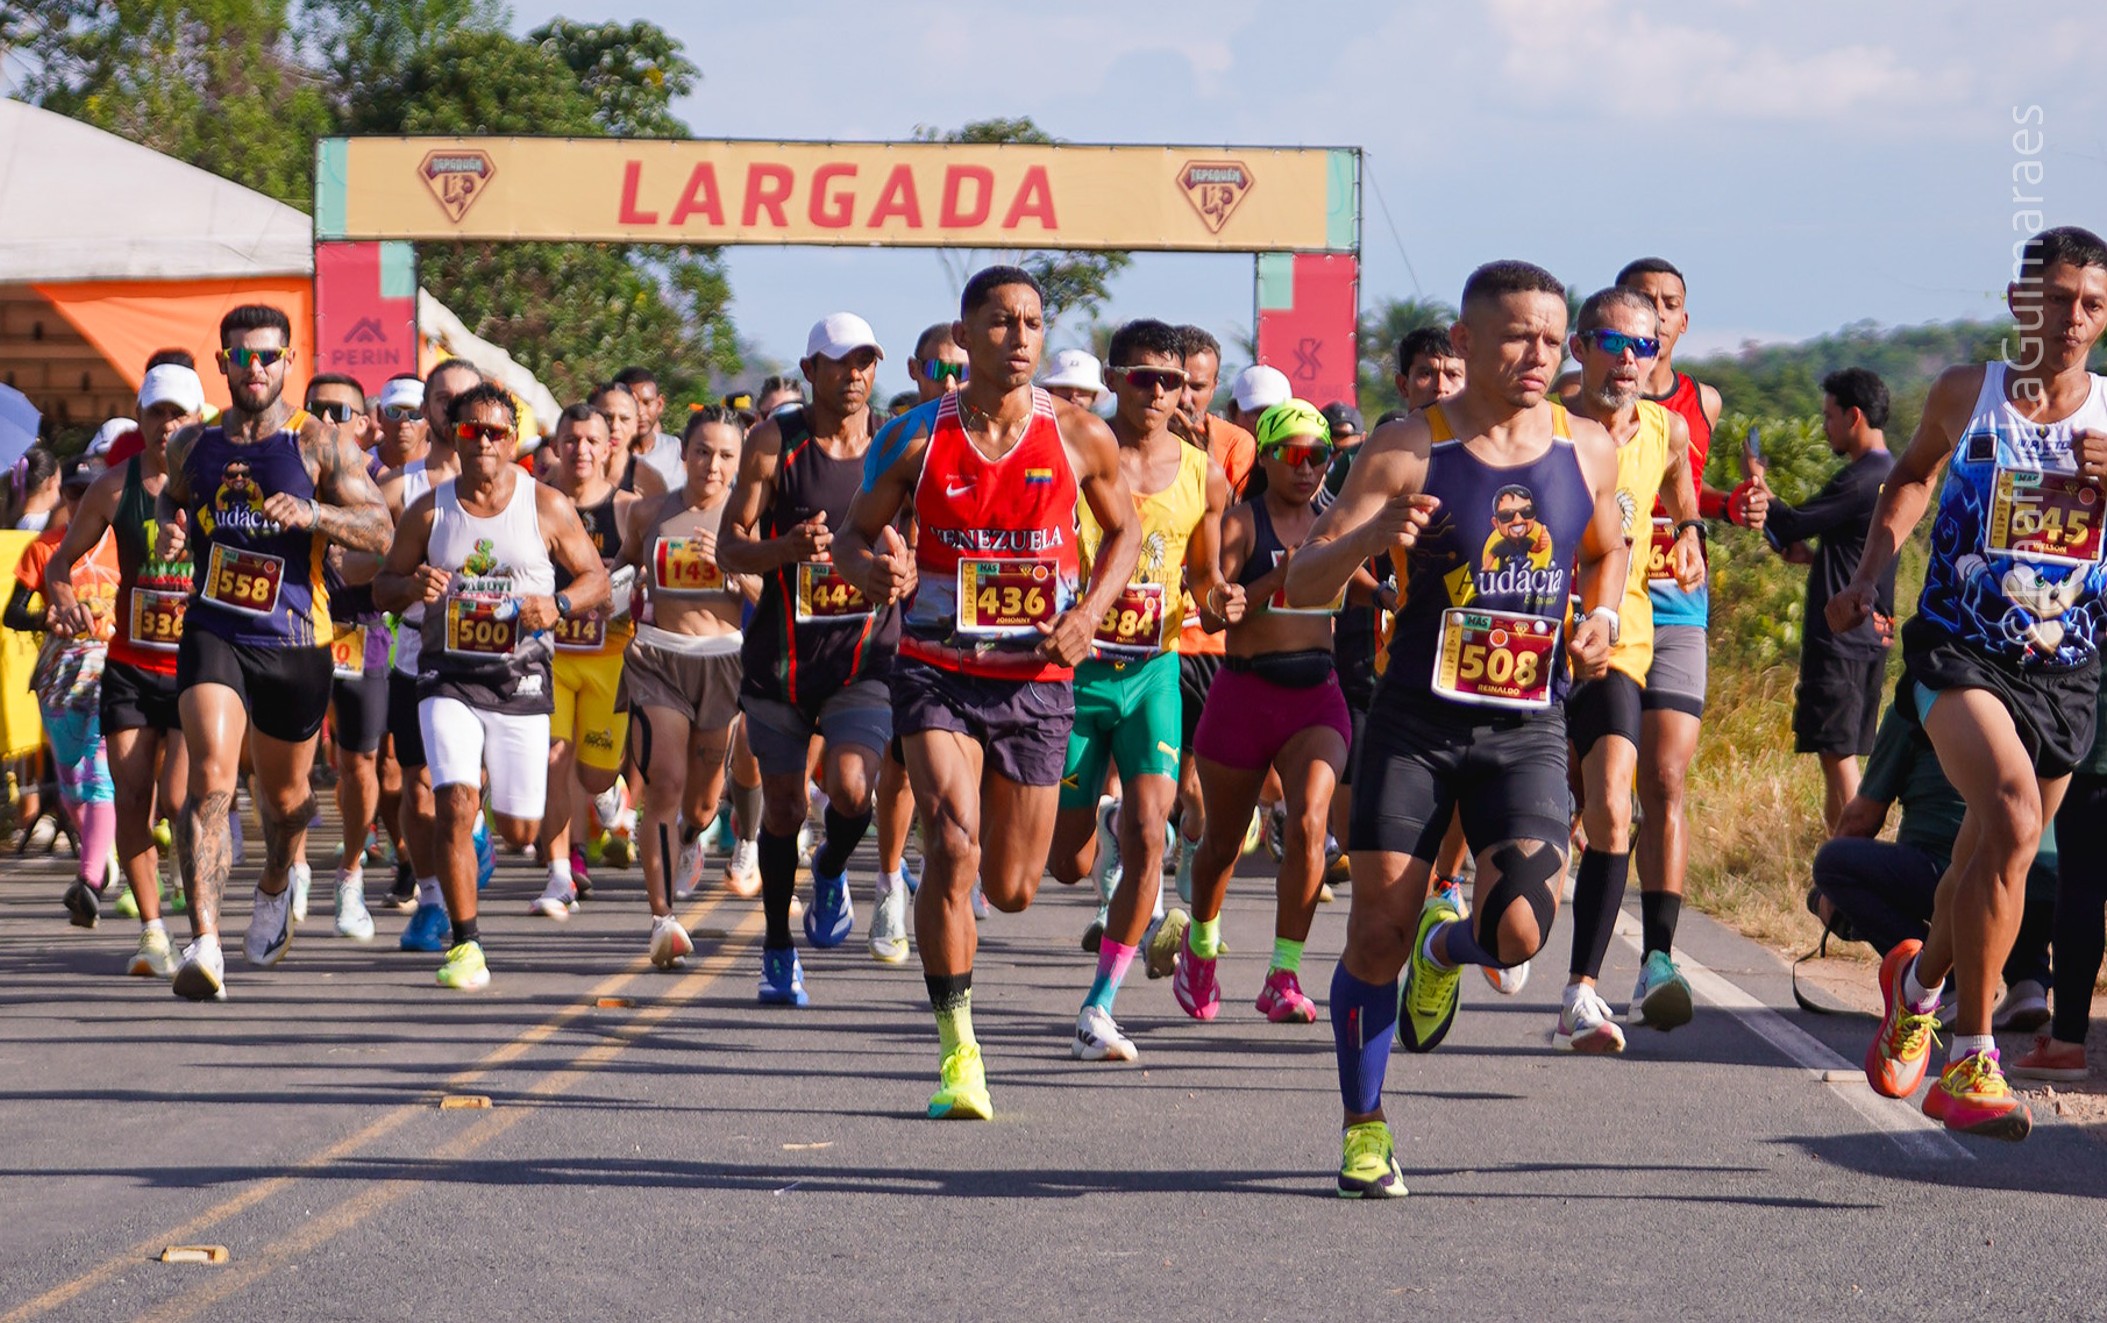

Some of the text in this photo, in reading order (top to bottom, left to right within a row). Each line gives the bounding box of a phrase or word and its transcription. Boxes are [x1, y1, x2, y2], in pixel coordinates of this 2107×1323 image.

[618, 160, 1059, 230] LARGADA
[332, 348, 400, 366] PERIN
[929, 524, 1064, 552] VENEZUELA
[2011, 501, 2091, 547] 545
[979, 563, 998, 573] MAS
[1451, 559, 1565, 597] Audácia
[219, 568, 271, 602] 558
[812, 583, 864, 608] 442
[977, 586, 1047, 617] 436
[458, 618, 510, 645] 500
[1466, 615, 1489, 627] MAS
[1459, 643, 1540, 688] 508
